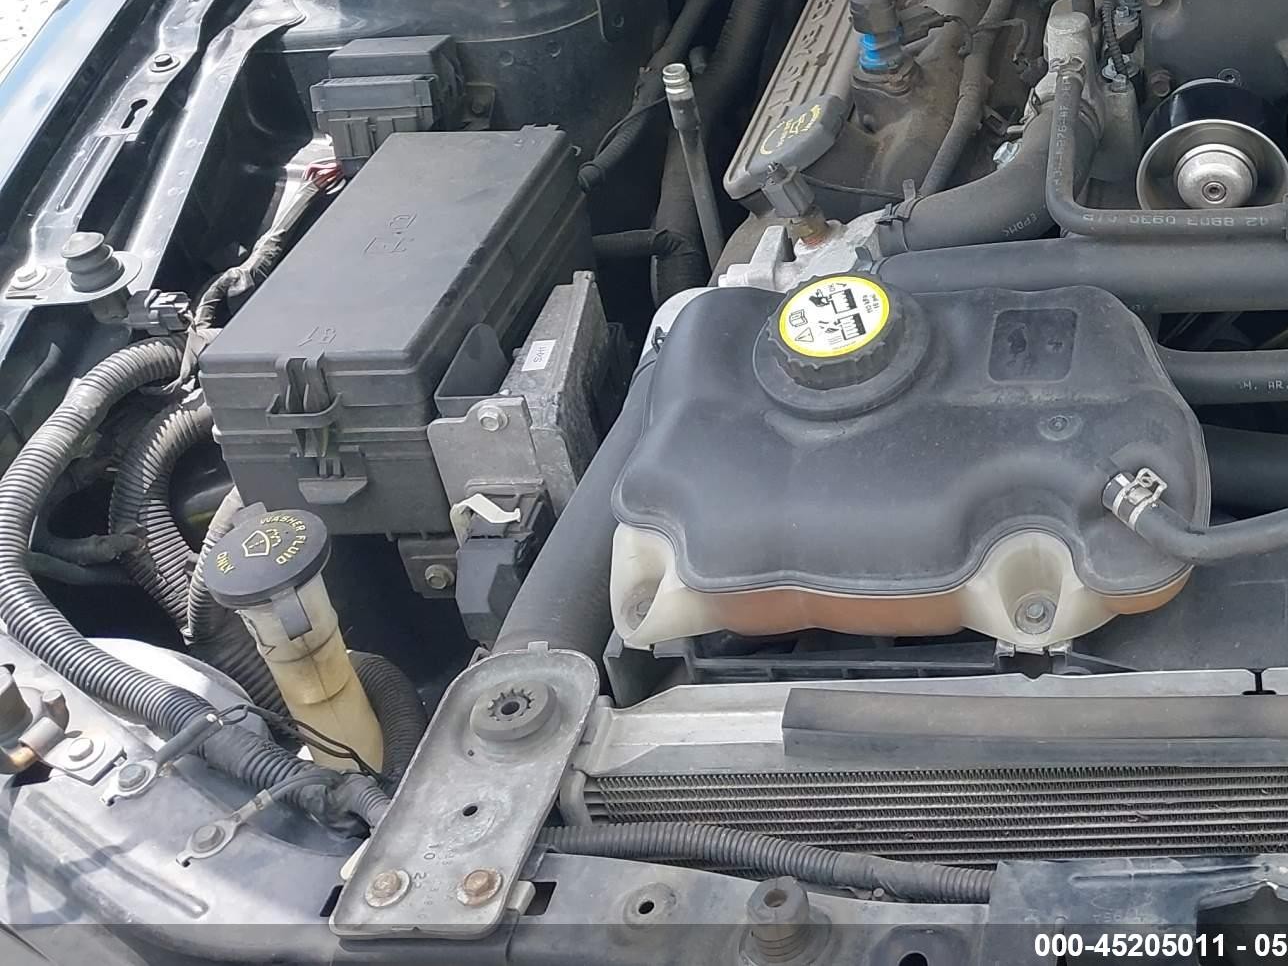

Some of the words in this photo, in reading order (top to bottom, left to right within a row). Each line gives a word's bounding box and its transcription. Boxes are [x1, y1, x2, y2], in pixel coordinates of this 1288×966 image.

[260, 514, 307, 532] WASHER
[275, 535, 307, 565] FLUID
[216, 551, 236, 574] ONLY
